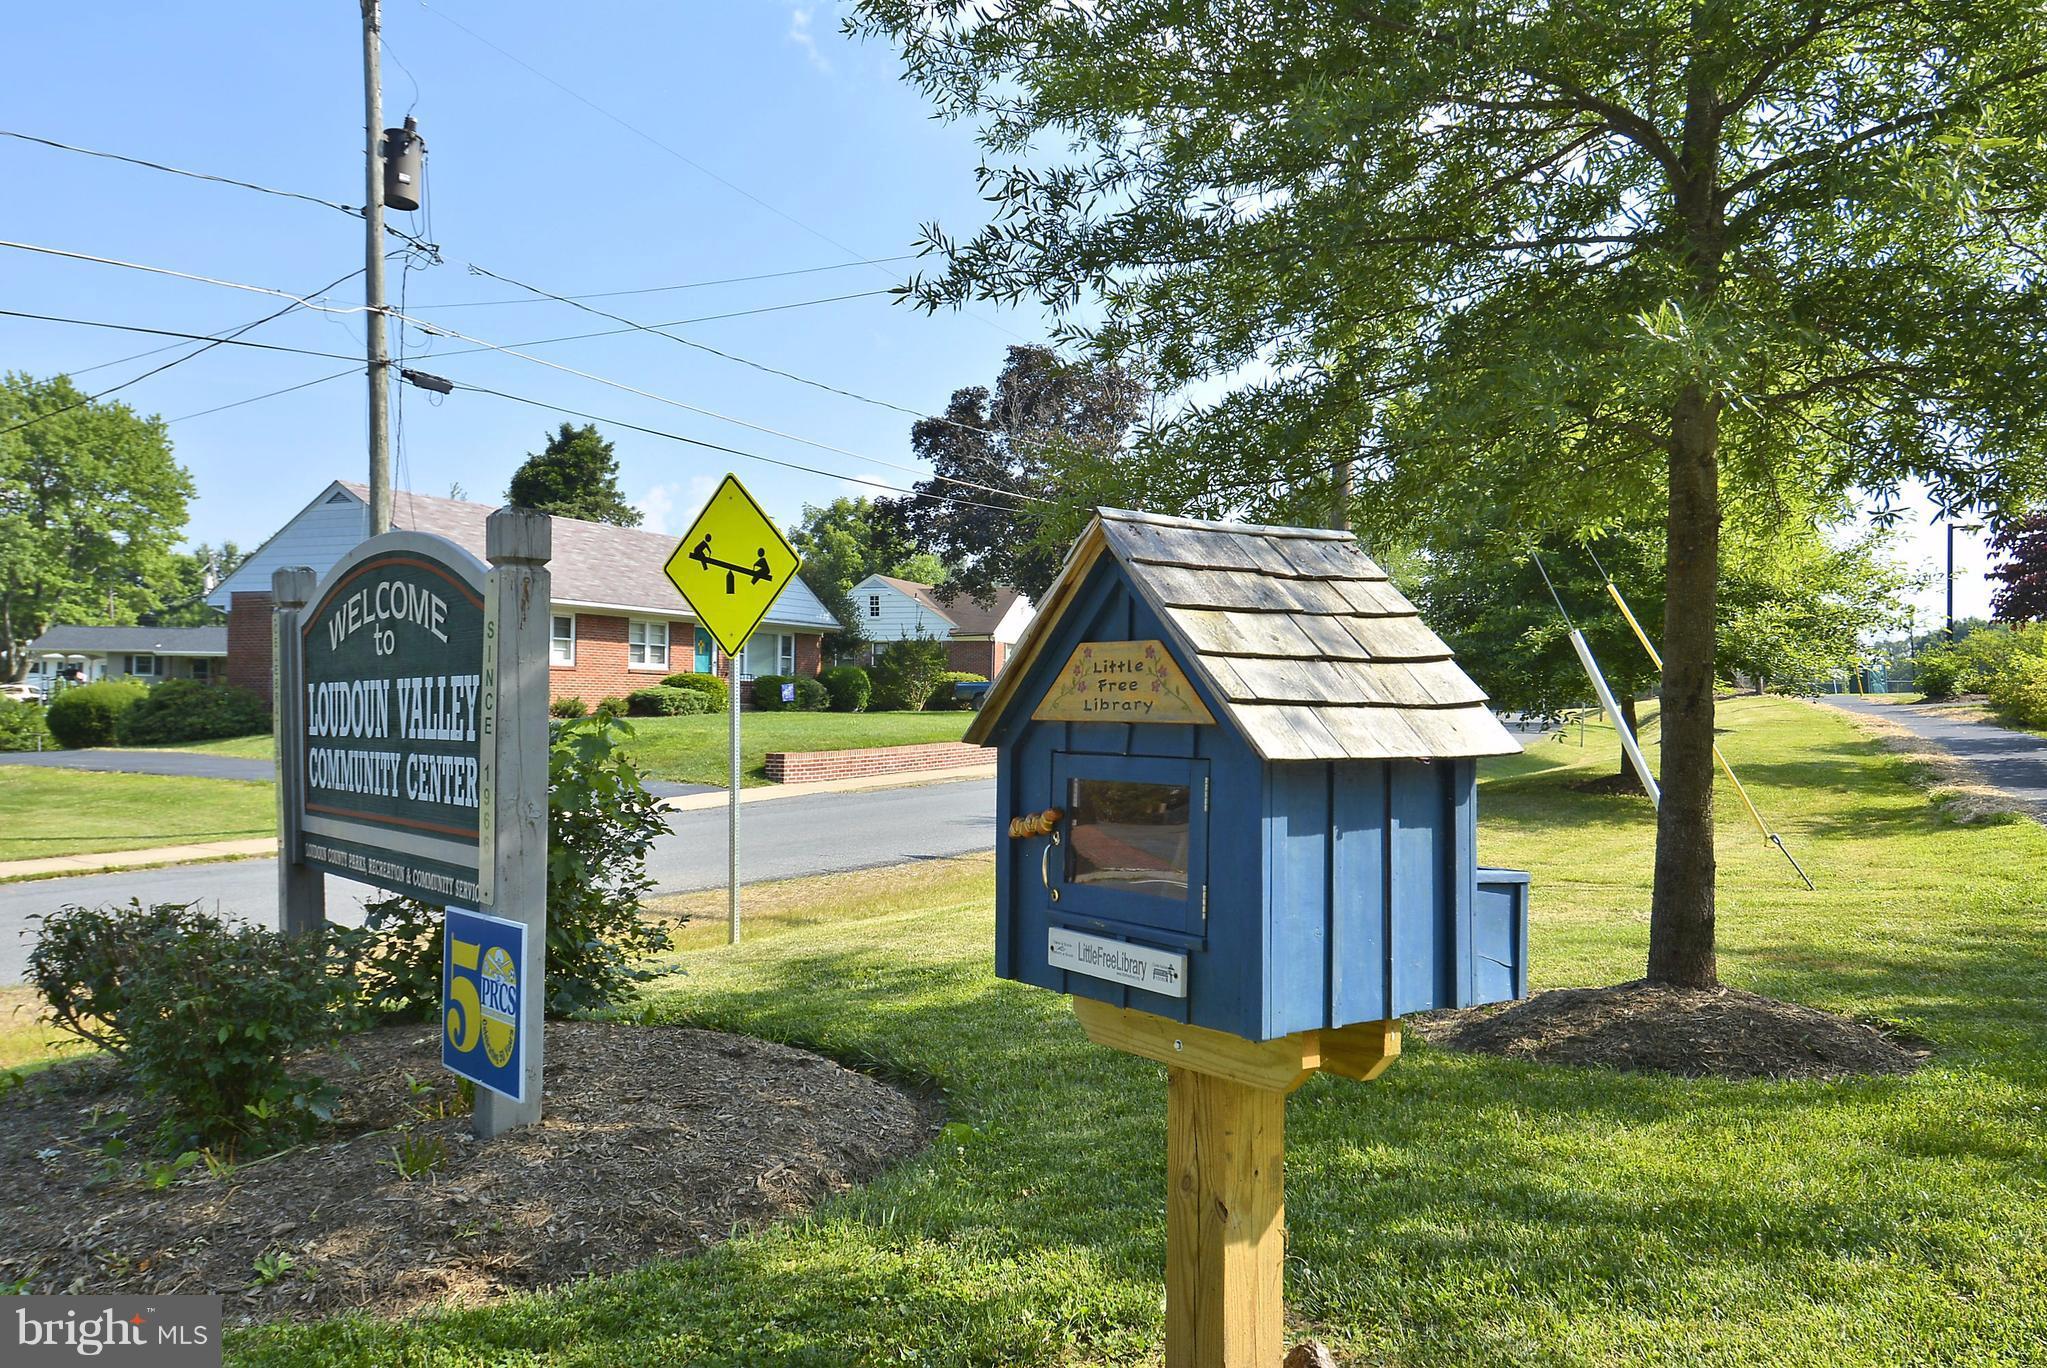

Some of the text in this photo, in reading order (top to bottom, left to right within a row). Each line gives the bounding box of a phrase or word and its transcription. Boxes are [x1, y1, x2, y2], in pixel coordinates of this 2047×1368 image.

[328, 580, 449, 651] WELCOME
[373, 623, 395, 656] to
[1093, 660, 1144, 674] Little
[1098, 679, 1138, 692] Free
[307, 679, 390, 739] LOUDOUN
[396, 674, 480, 742] VALLEY
[1084, 698, 1153, 714] Library
[482, 620, 494, 852] SINCE 1966
[308, 747, 479, 808] COMMUNITY CENTER
[305, 842, 327, 862] LOUDOUN
[327, 848, 348, 867] COUNTY
[368, 859, 405, 882] RECREATION
[406, 868, 411, 884] &
[412, 870, 454, 895] COMMUNITY
[1077, 941, 1148, 981] LittleFreeLibrary
[481, 976, 516, 1016] PRCS
